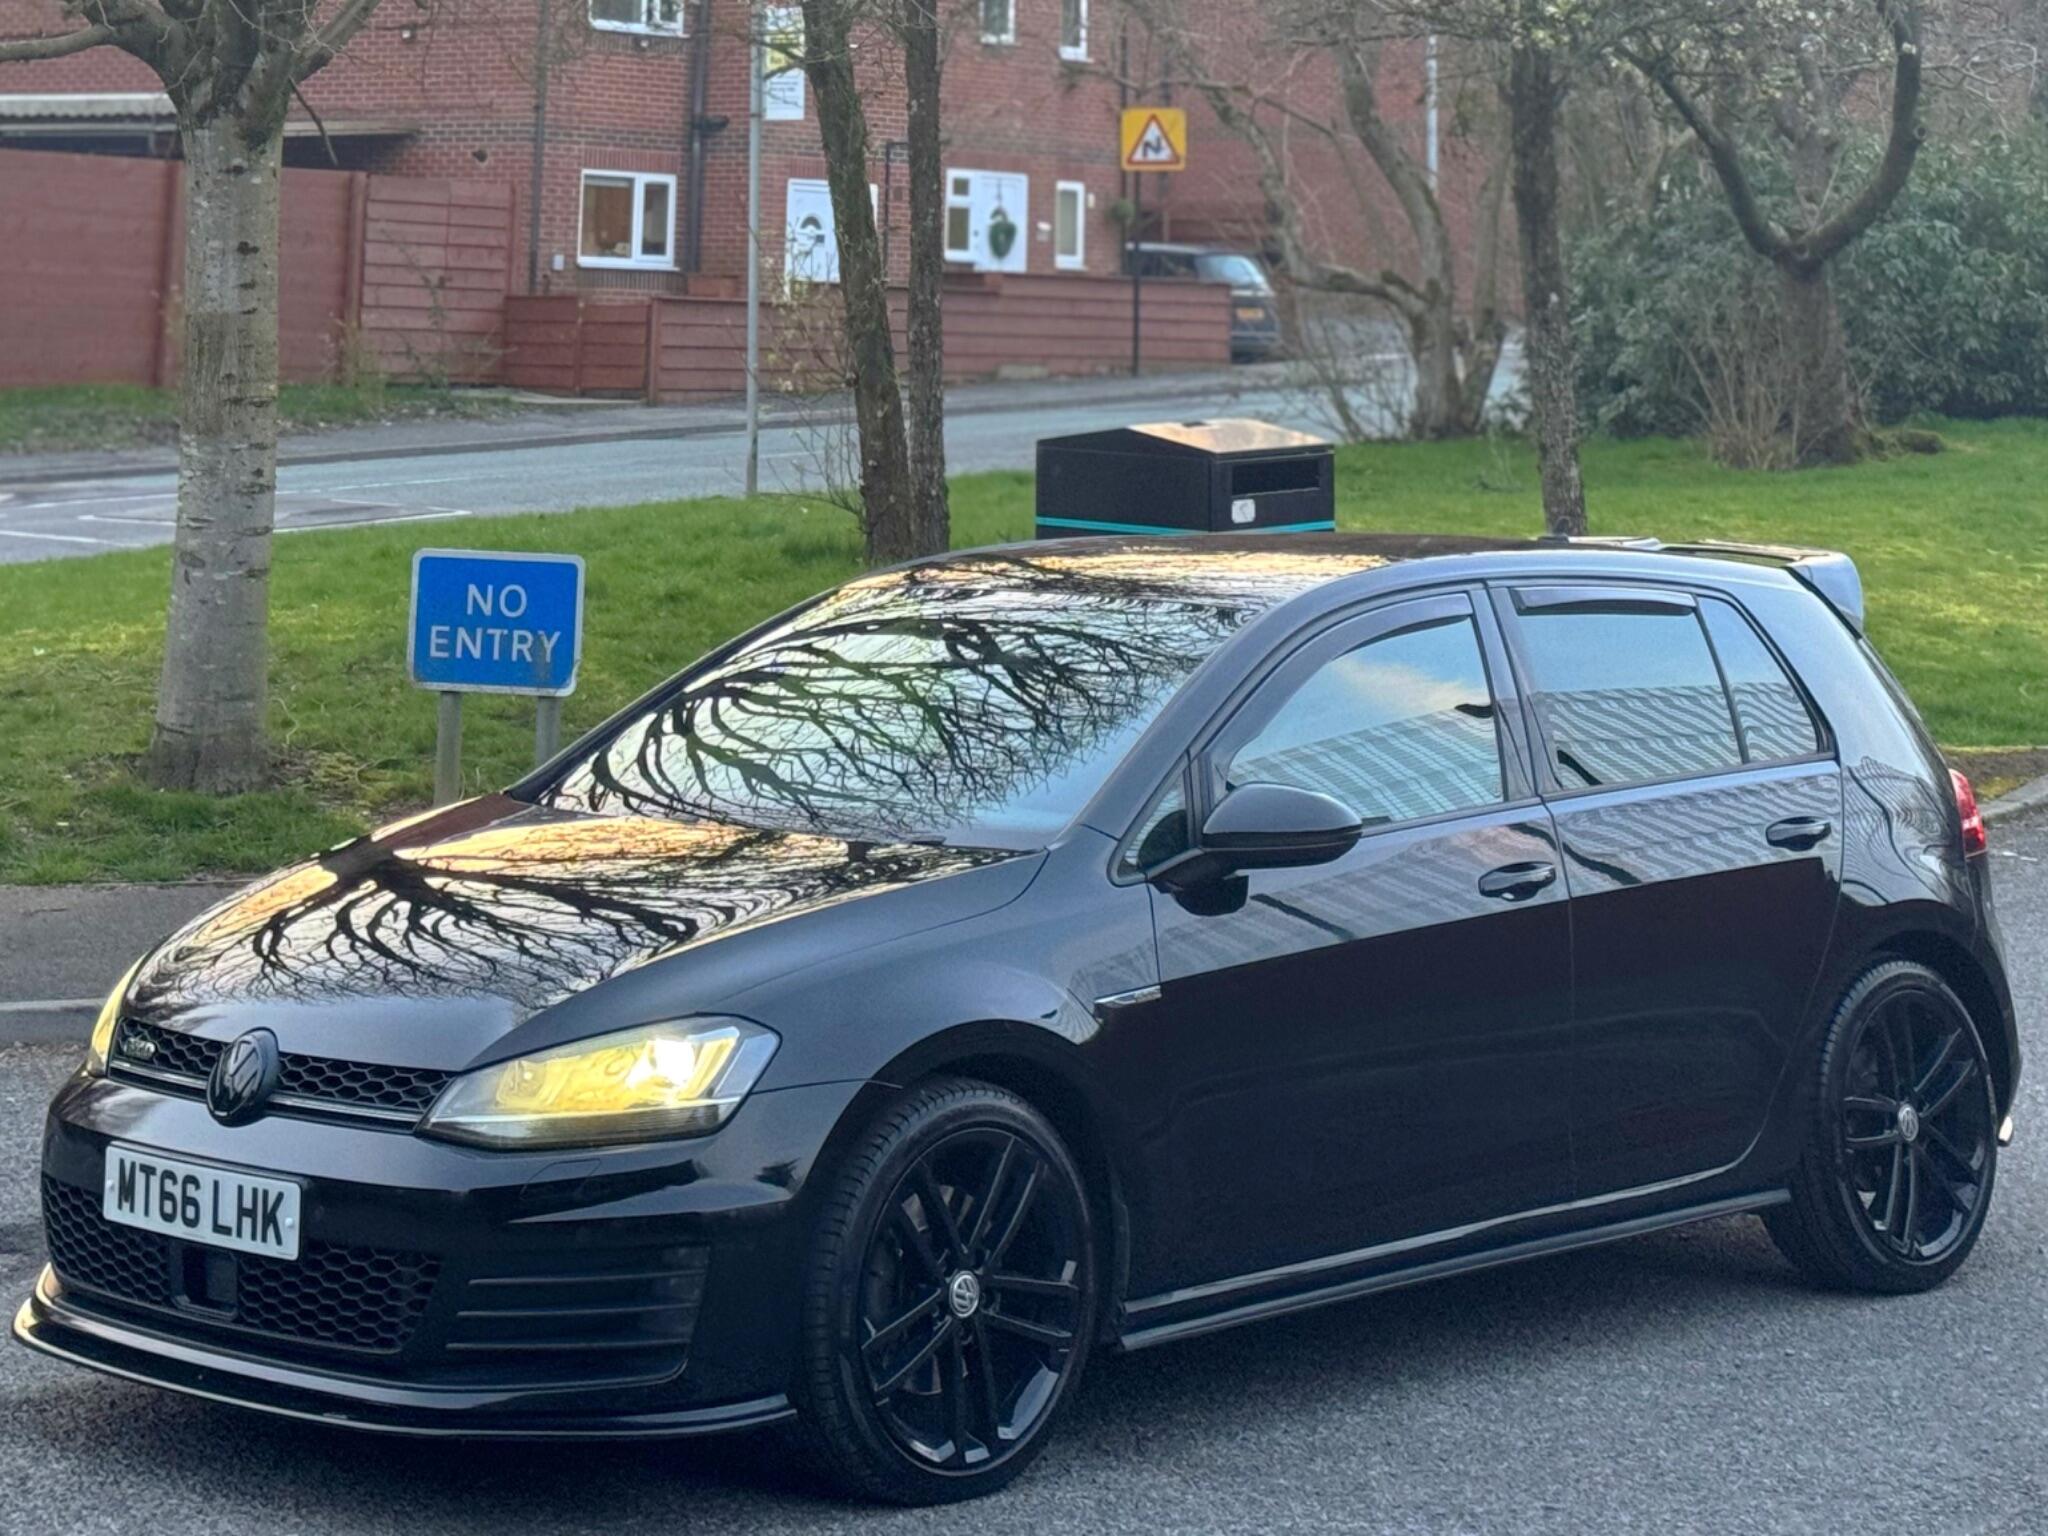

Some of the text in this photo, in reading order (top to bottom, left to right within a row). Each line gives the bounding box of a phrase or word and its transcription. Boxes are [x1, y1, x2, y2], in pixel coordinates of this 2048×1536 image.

[466, 583, 528, 618] NO
[429, 624, 562, 663] ENTRY
[117, 1157, 285, 1247] MT66 LHK
